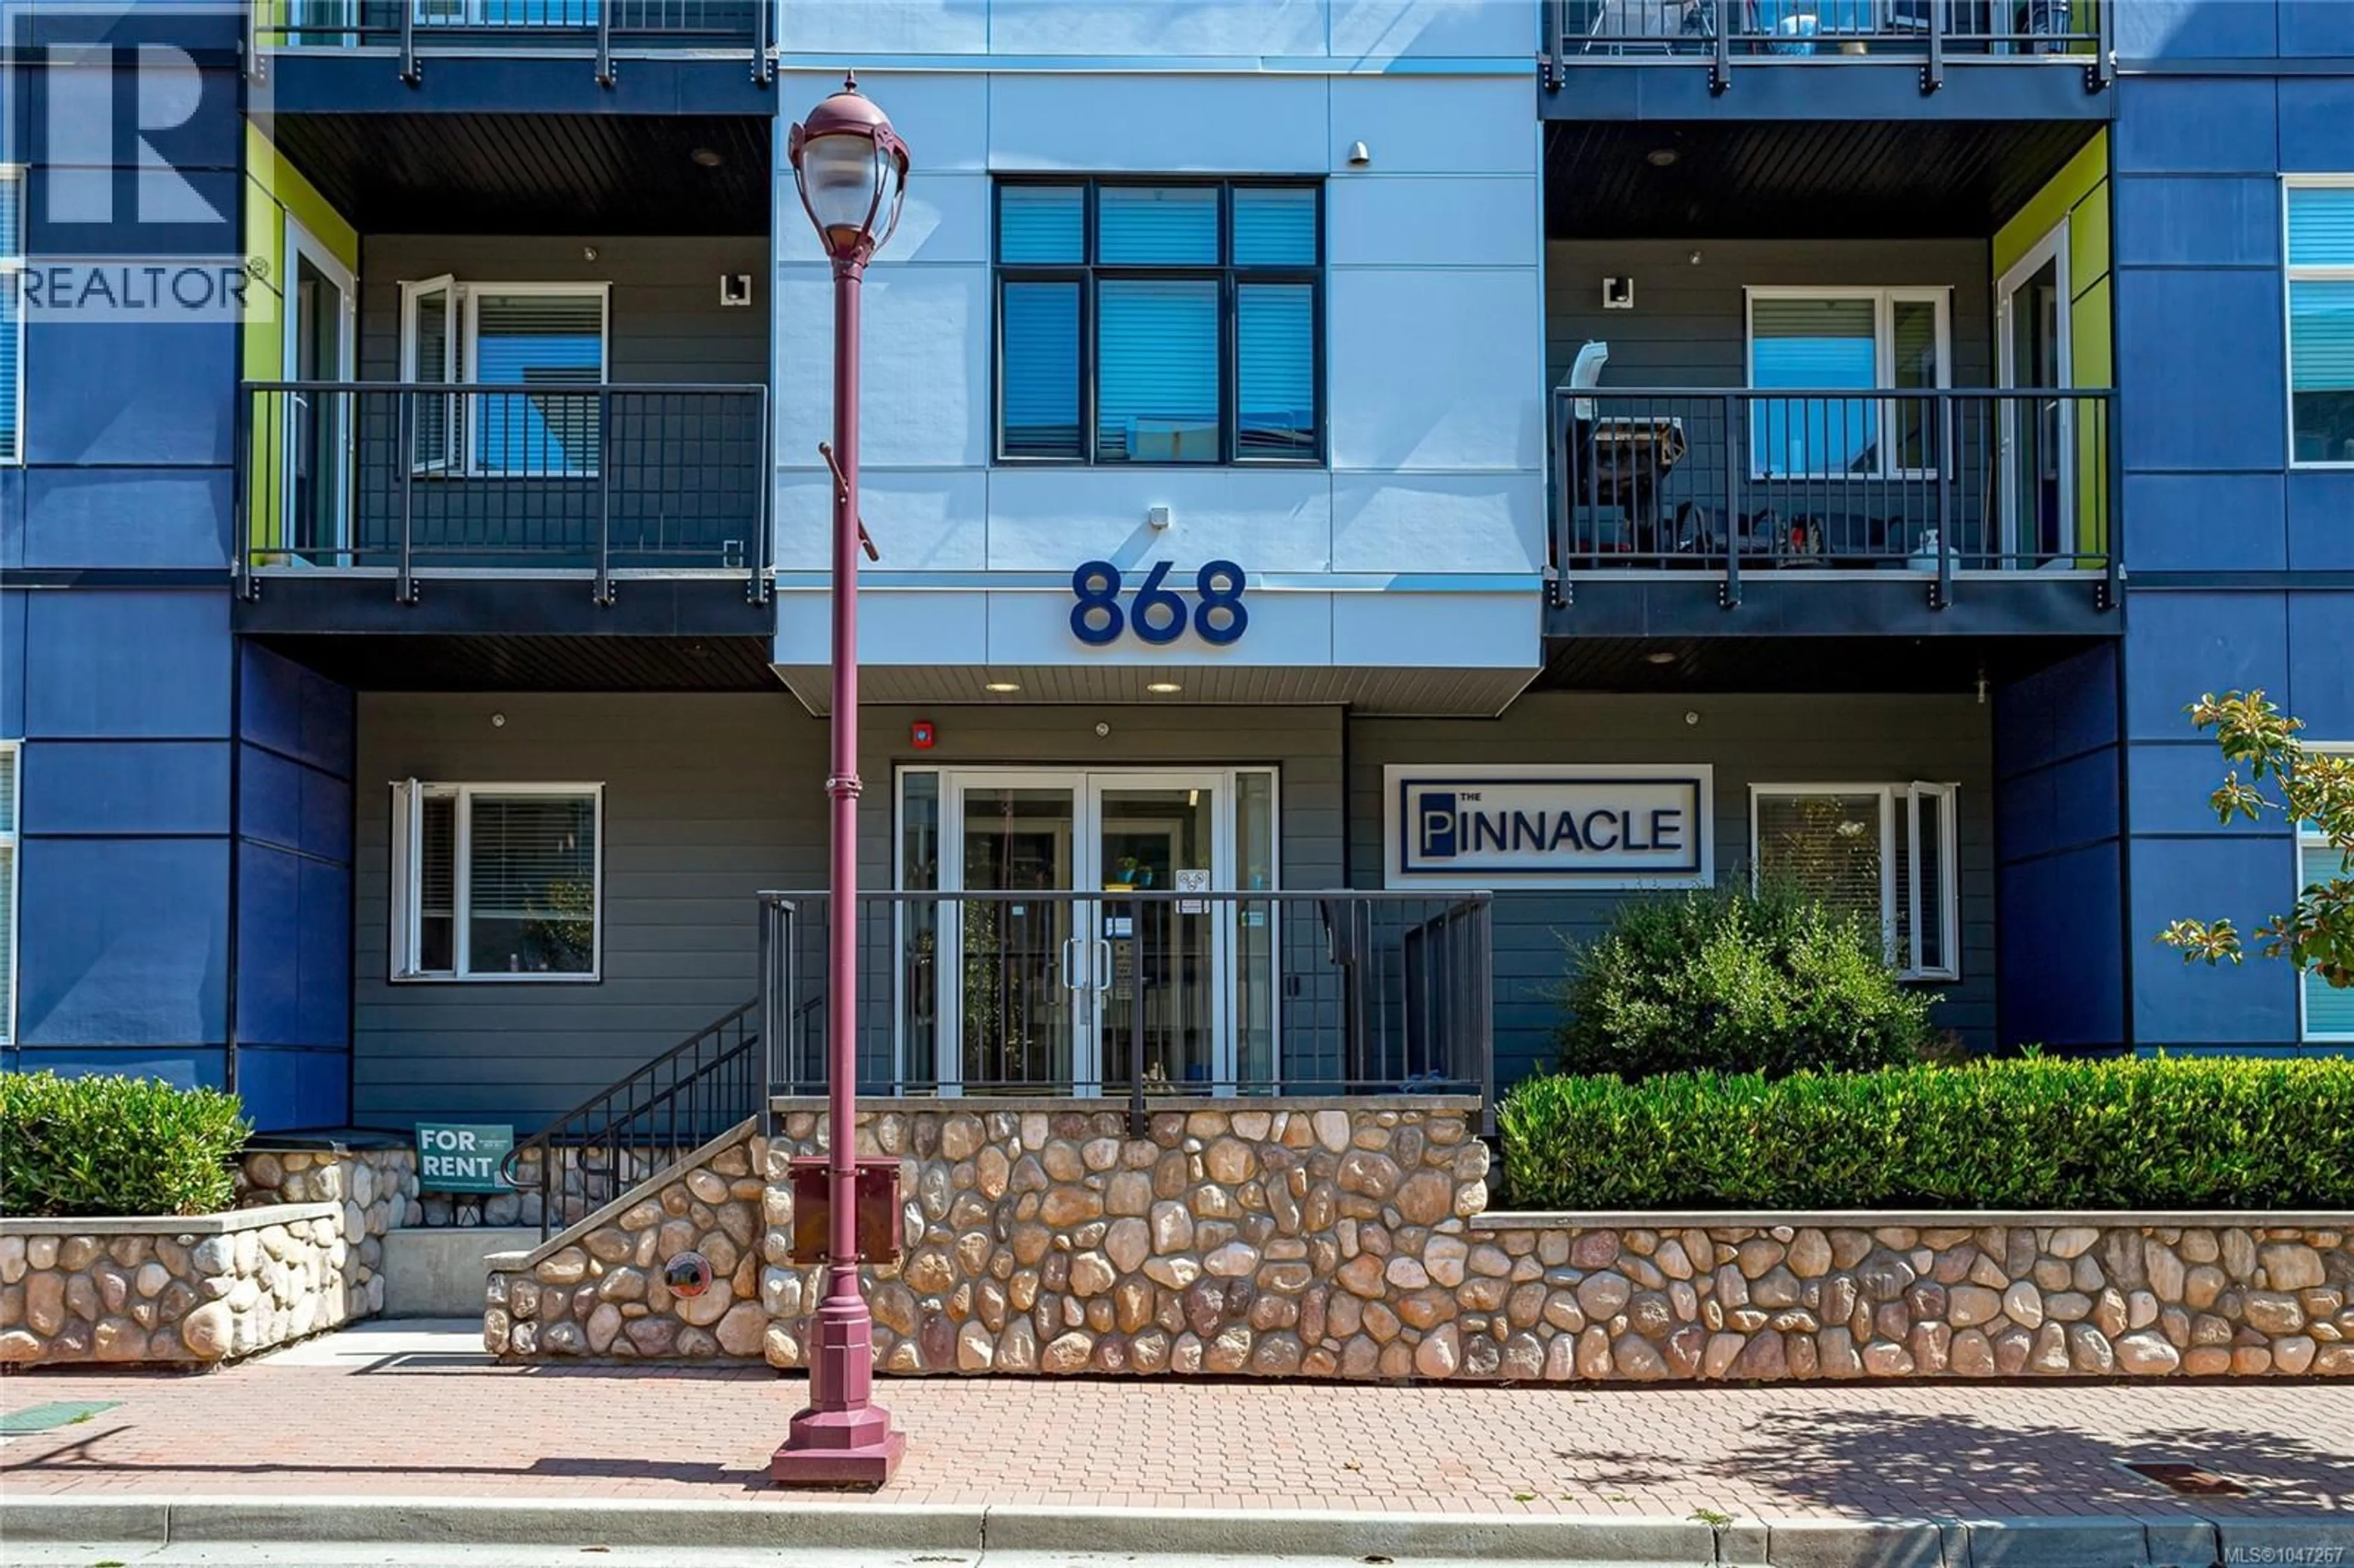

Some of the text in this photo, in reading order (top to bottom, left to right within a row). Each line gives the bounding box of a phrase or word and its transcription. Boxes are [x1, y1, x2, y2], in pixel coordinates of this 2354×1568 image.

[1070, 560, 1248, 645] 868
[1460, 793, 1482, 802] THE
[1423, 809, 1682, 851] PINNACLE
[421, 1130, 476, 1151] FOR
[423, 1155, 493, 1178] RENT
